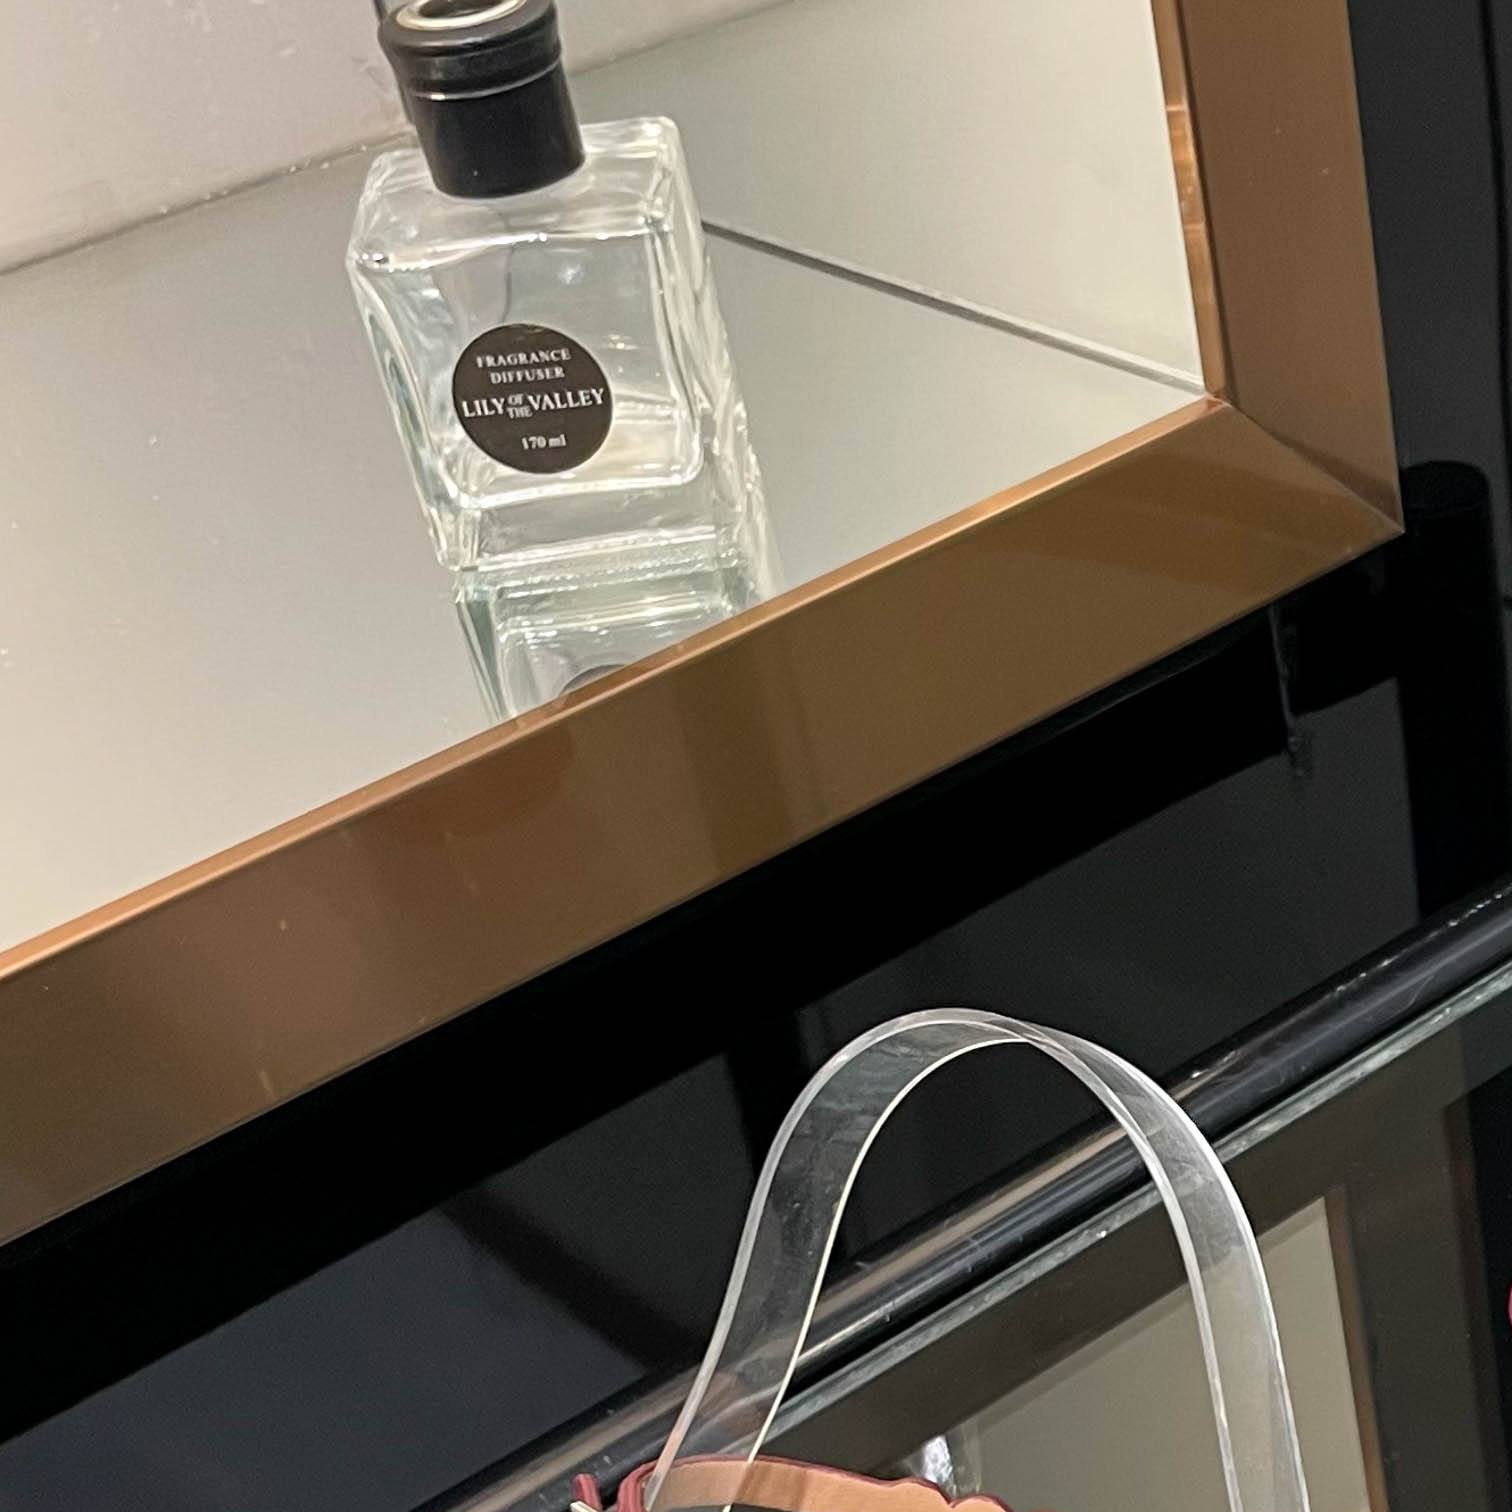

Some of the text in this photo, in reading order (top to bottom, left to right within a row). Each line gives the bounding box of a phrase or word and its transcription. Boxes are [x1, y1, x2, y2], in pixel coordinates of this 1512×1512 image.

[476, 348, 571, 368] FRAGRANCE
[490, 366, 566, 384] DIFFUSER
[461, 388, 604, 419] LILY OF THE VALLEY
[521, 434, 567, 450] 170 ml
